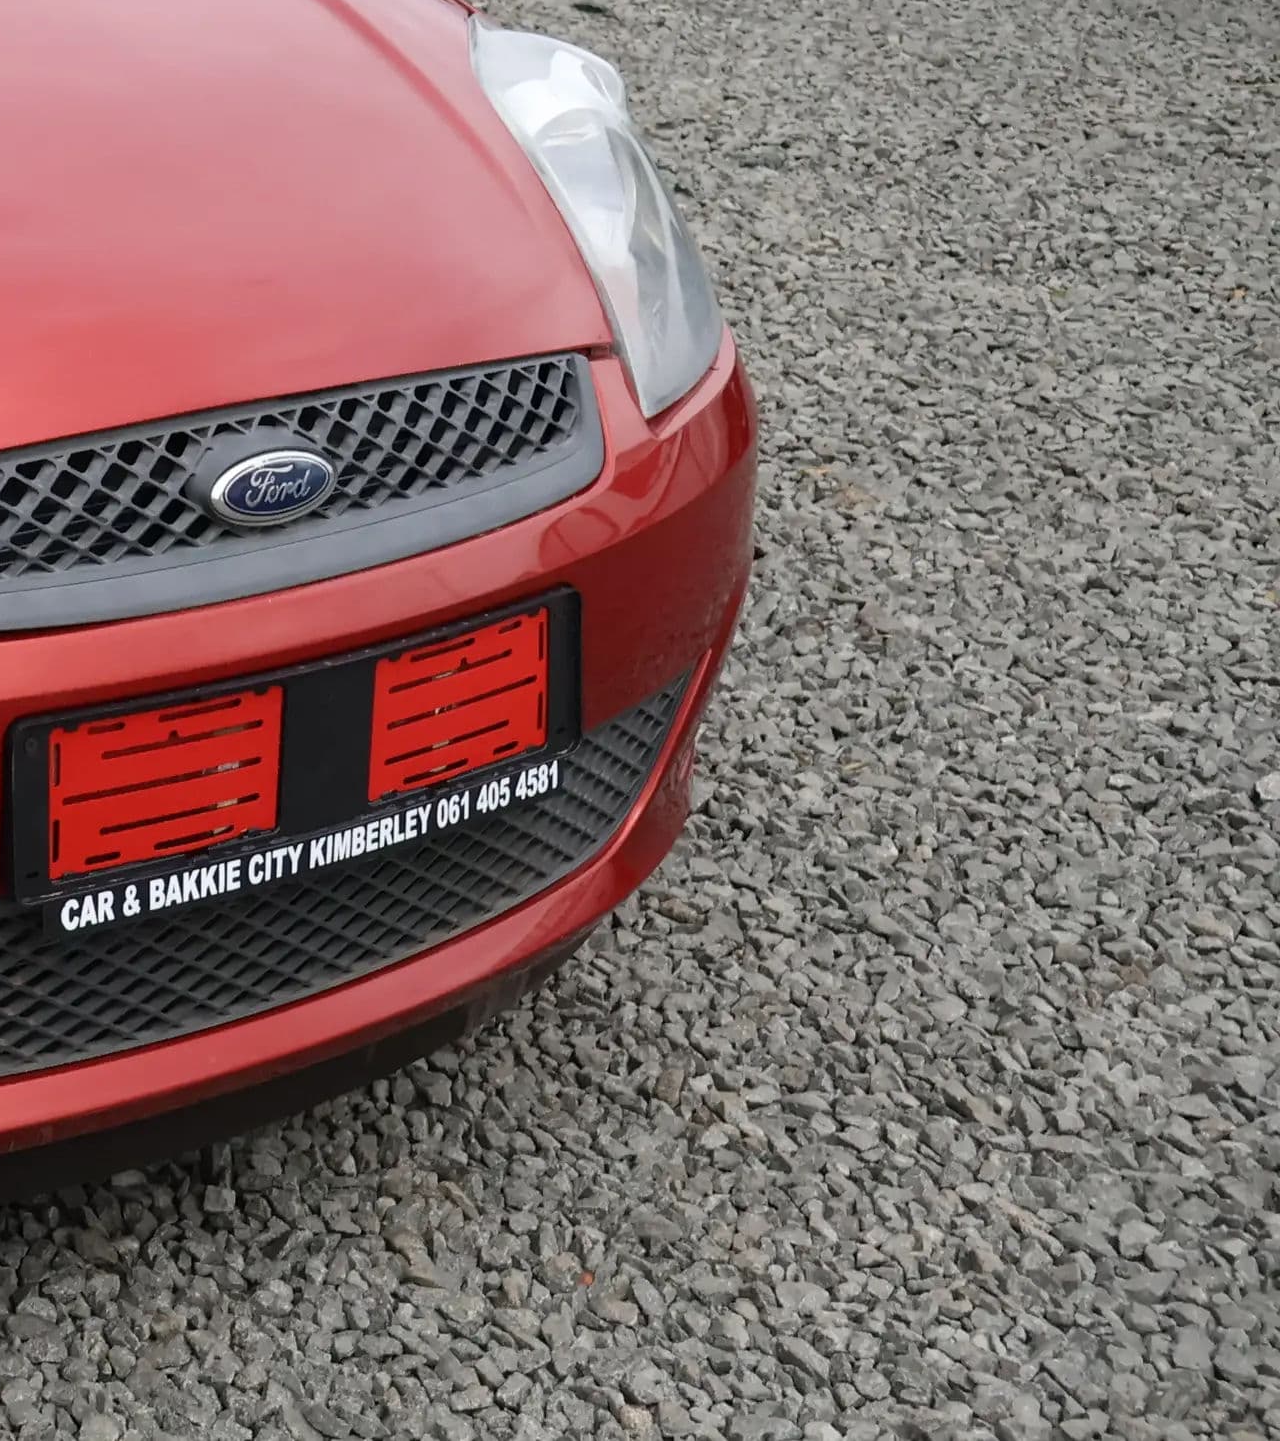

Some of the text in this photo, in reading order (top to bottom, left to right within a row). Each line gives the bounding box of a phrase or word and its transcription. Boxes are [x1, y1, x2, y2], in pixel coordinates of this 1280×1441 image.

[245, 464, 311, 508] Ford
[60, 760, 558, 931] CAR & BAKKIE CITY KIMBERLEY 061 405 4581
